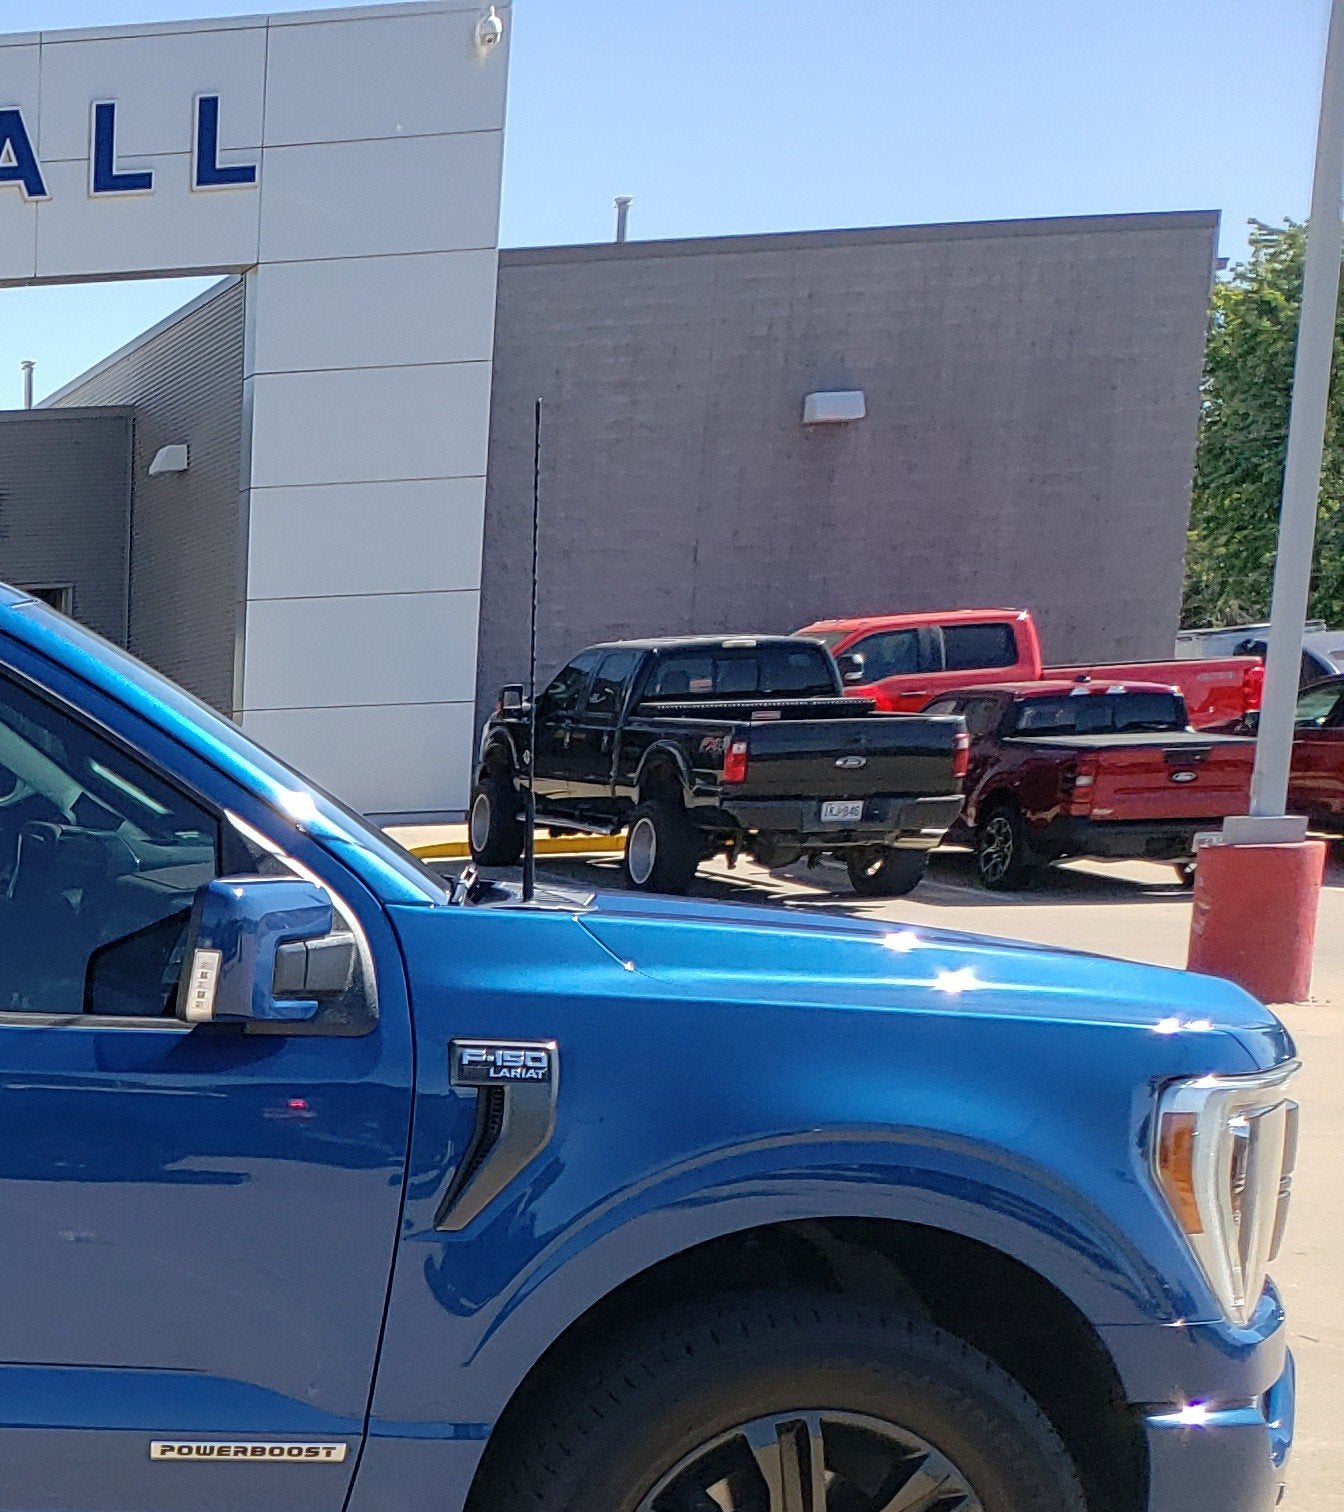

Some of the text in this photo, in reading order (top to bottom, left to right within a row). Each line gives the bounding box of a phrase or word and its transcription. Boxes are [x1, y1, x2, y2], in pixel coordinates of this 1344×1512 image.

[461, 1048, 549, 1067] F-150
[488, 1067, 549, 1080] LARIAT
[159, 1443, 338, 1459] POWERBOOST
